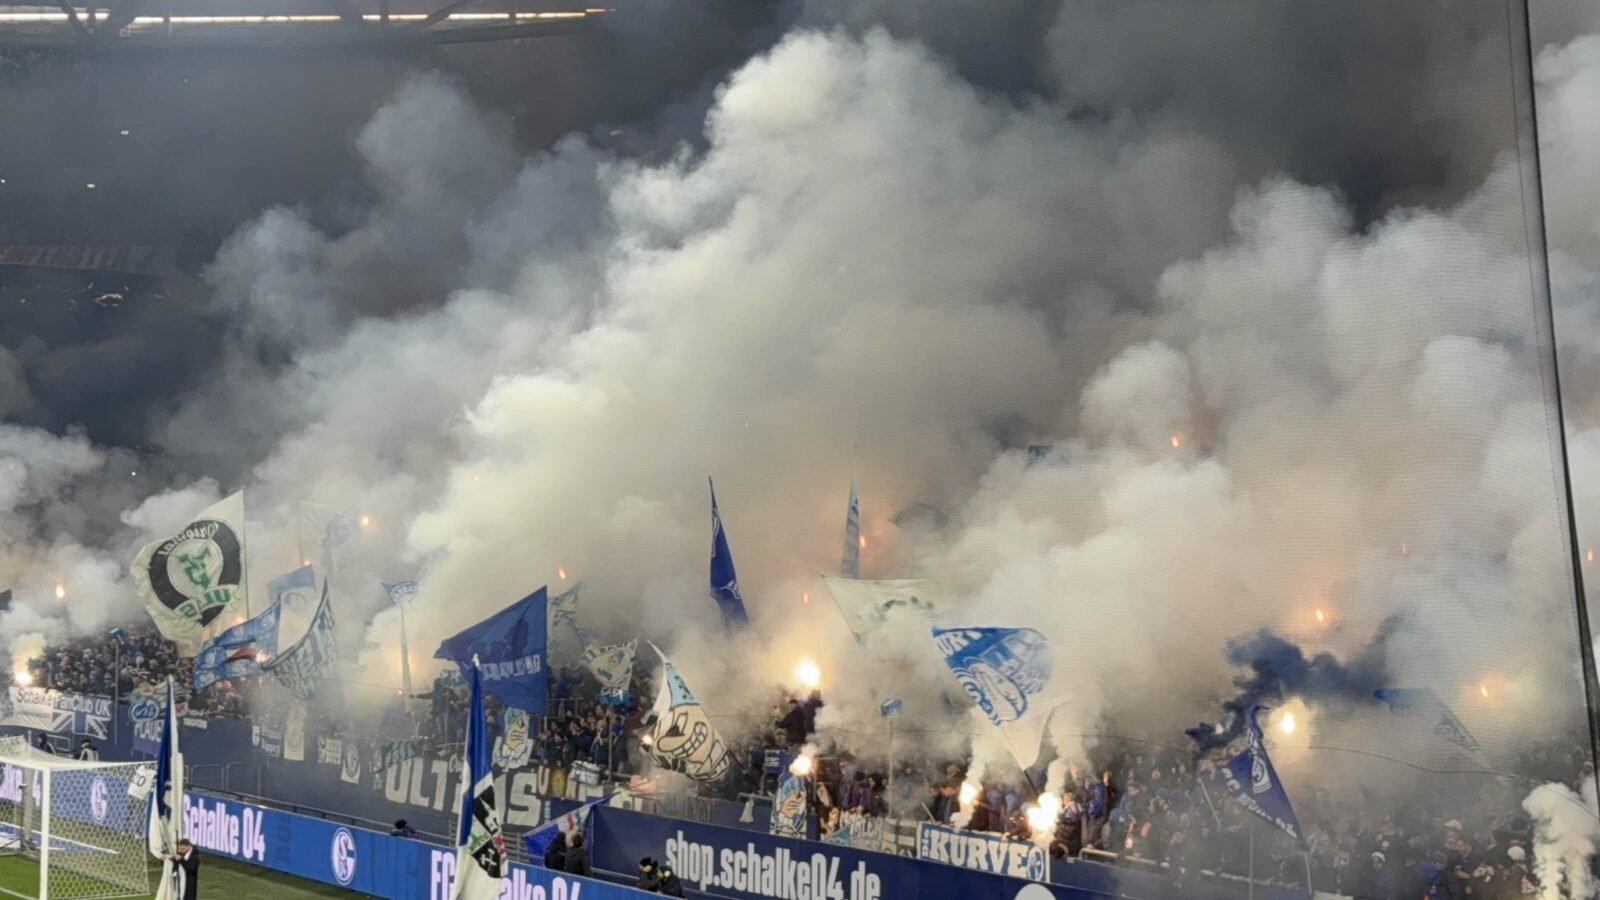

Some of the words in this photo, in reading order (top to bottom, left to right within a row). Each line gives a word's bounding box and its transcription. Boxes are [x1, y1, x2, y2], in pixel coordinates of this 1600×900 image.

[94, 698, 112, 717] UK
[385, 757, 542, 827] ULTS
[182, 794, 239, 854] Schalke
[243, 808, 265, 861] 04
[929, 829, 1029, 878] KURVE
